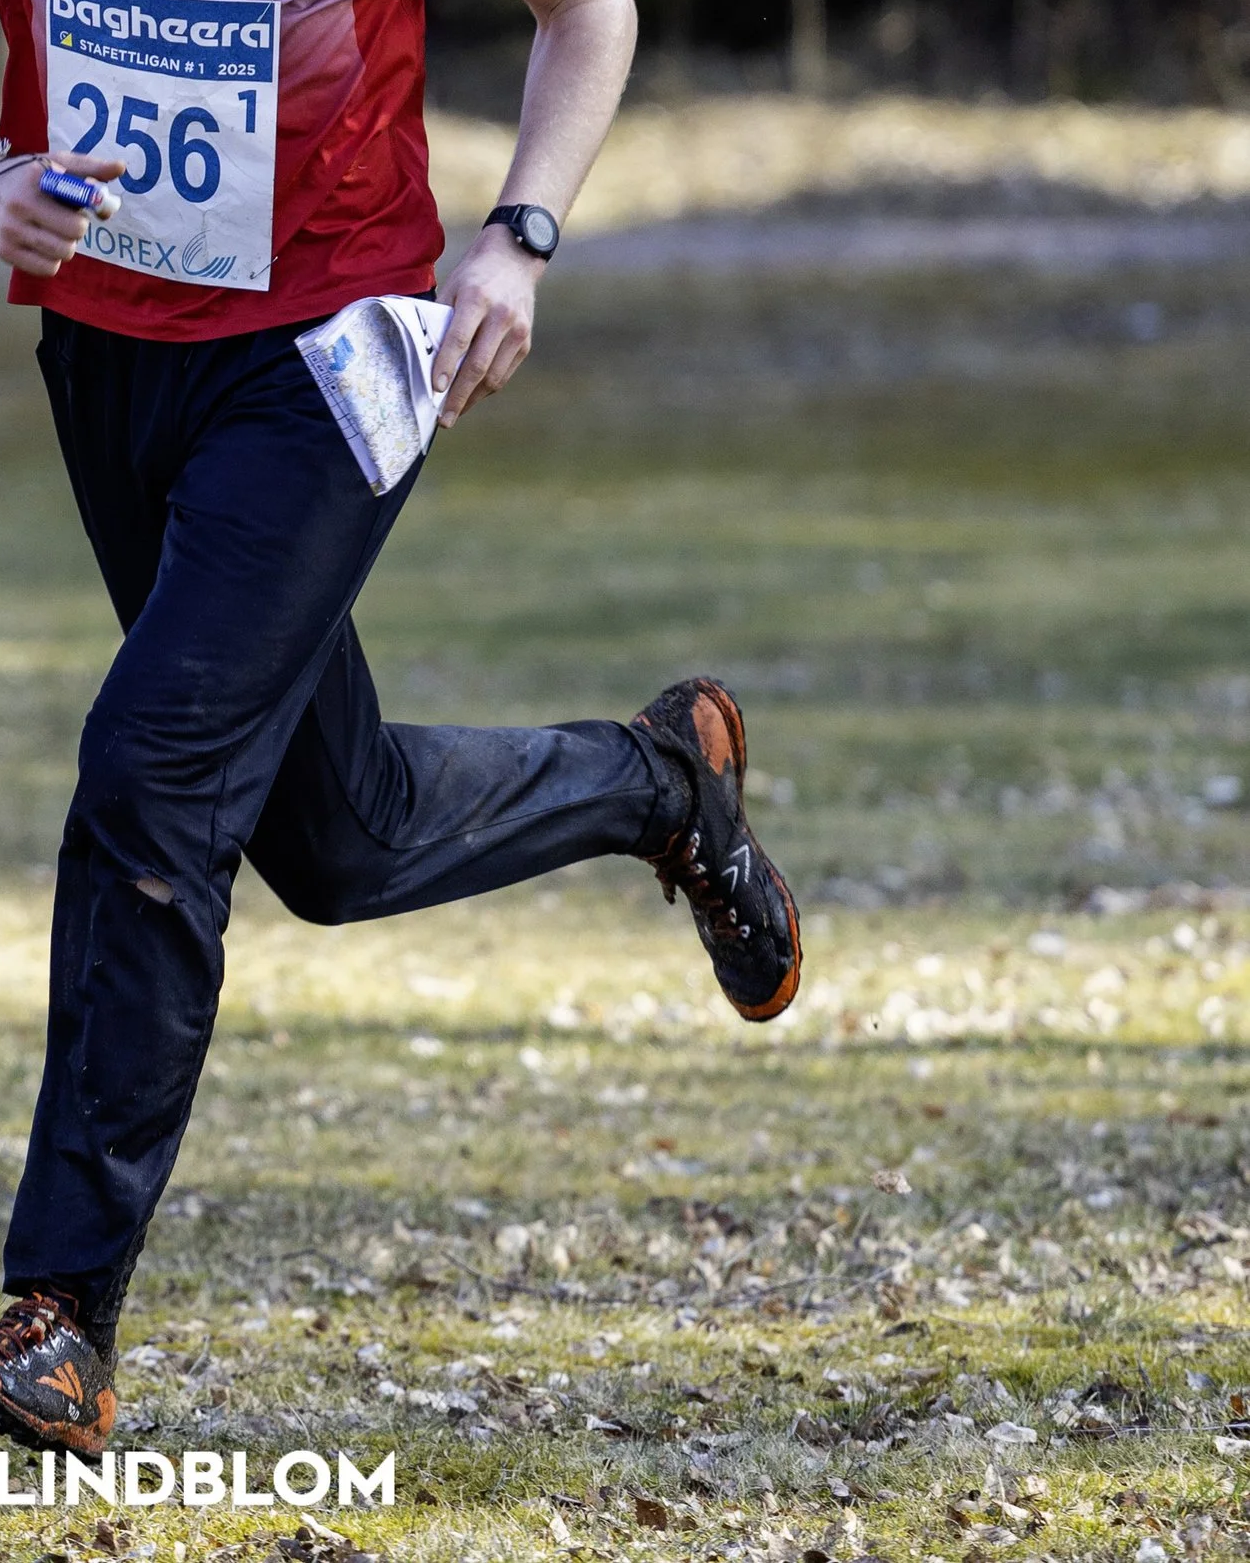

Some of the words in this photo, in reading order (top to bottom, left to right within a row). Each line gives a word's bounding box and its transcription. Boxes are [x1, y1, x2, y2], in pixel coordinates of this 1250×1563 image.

[79, 39, 181, 72] STAFETTLIGAN
[217, 63, 257, 76] 2025
[67, 82, 222, 204] 256
[237, 89, 257, 134] 1
